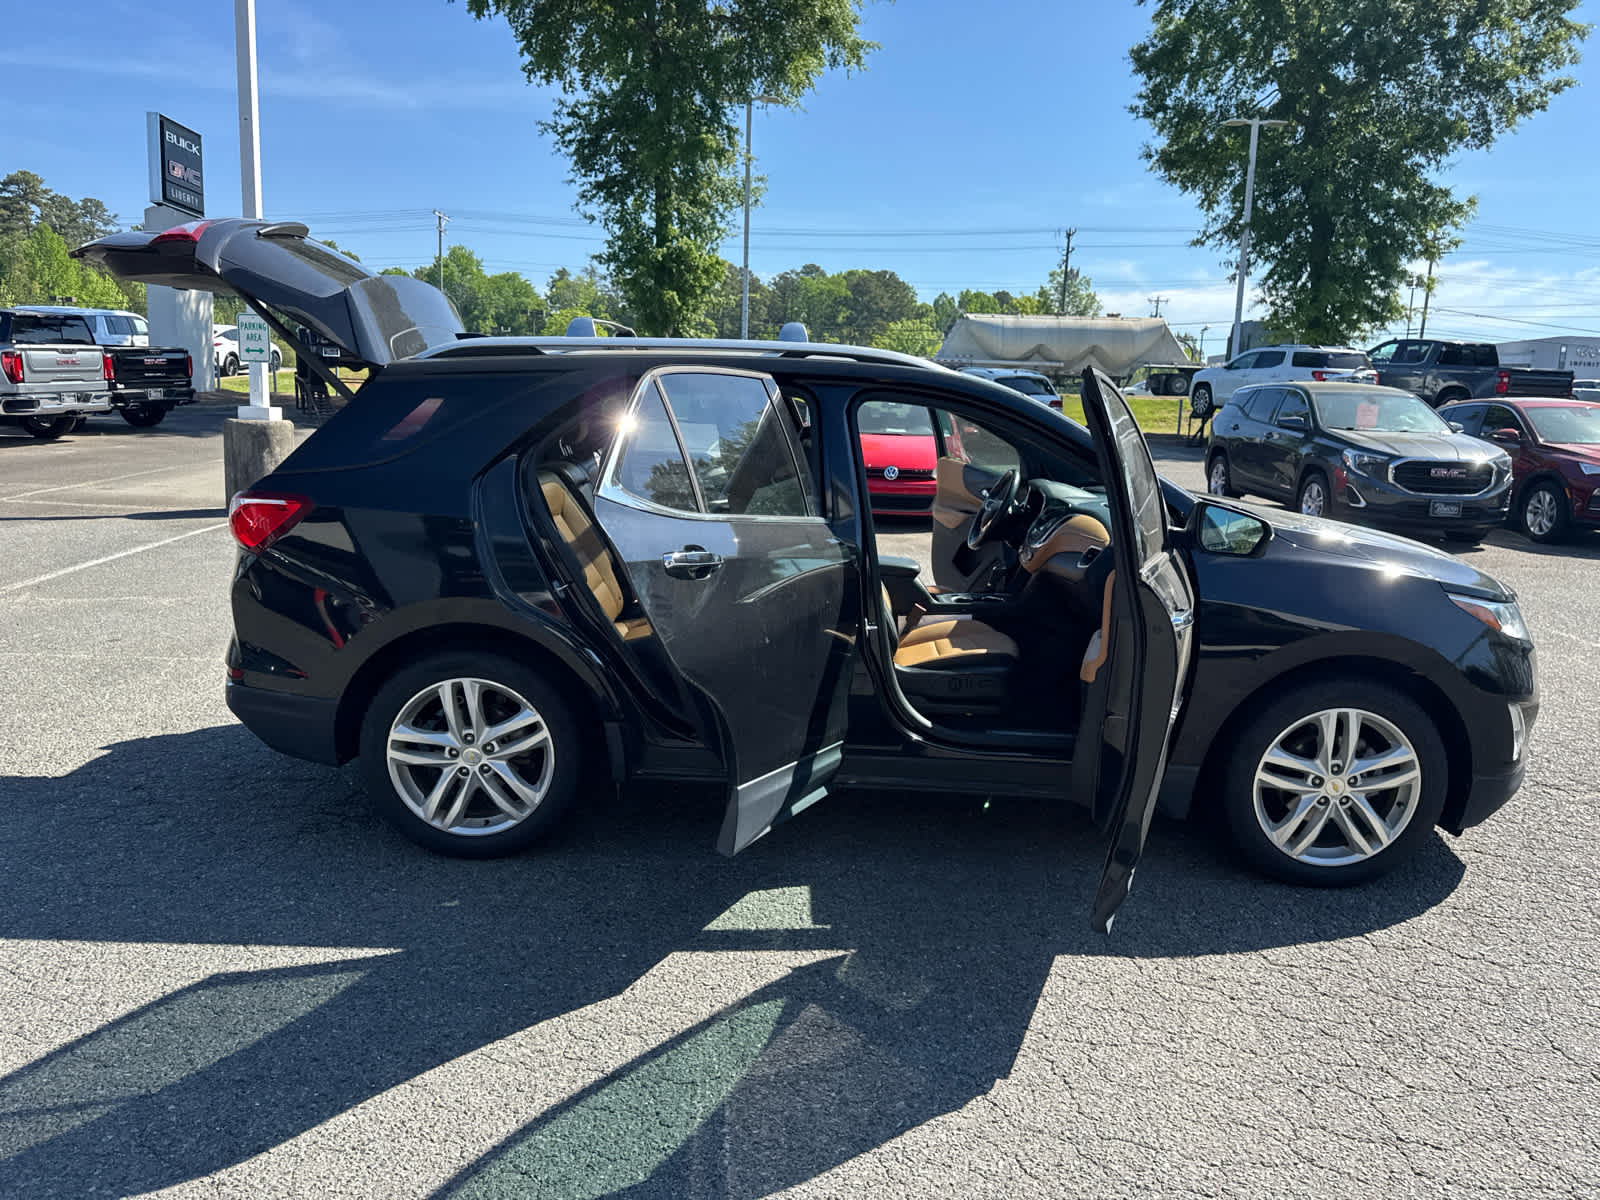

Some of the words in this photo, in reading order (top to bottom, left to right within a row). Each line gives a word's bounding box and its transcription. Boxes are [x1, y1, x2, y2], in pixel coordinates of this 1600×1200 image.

[165, 130, 200, 156] BUICK
[168, 160, 201, 188] GMC
[171, 187, 199, 207] LIBERTY
[240, 322, 266, 331] PARKING
[246, 333, 262, 341] AREA
[1431, 468, 1466, 477] GMC
